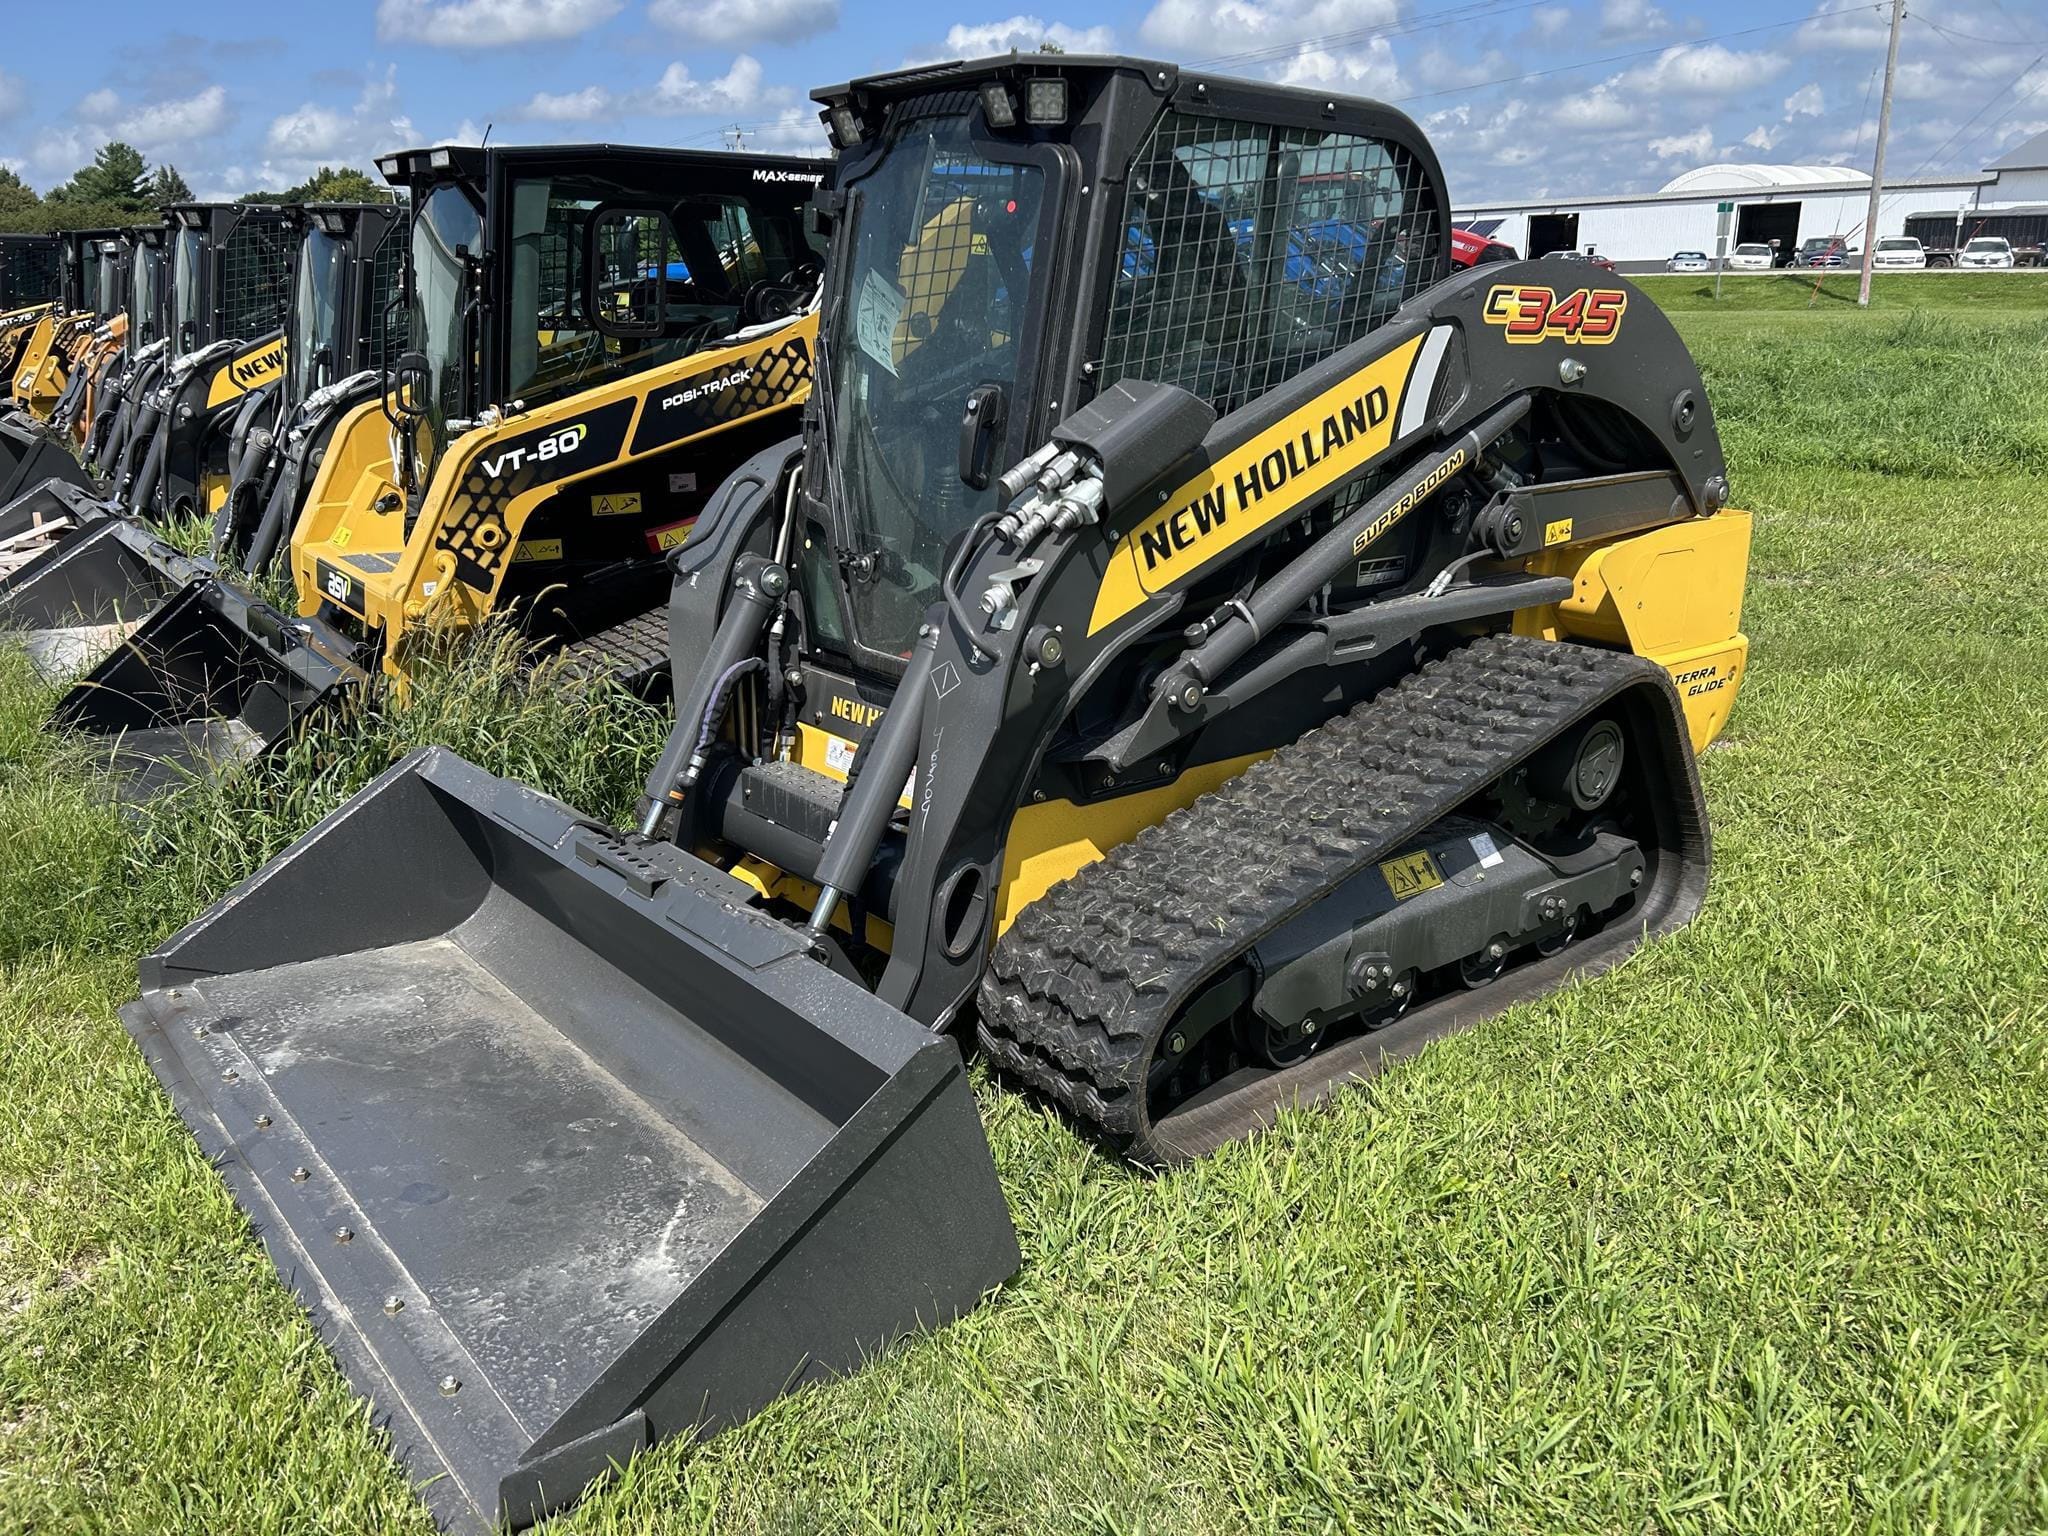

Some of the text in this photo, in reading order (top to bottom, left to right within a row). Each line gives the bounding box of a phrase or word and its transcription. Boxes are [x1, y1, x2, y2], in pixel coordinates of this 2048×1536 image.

[1483, 285, 1627, 342] C345
[236, 349, 282, 381] NEW
[481, 430, 579, 478] VT-80
[1139, 385, 1389, 571] NEW HOLLAND
[1354, 450, 1463, 555] SUPER BOOM
[1674, 666, 1716, 685] TERRA
[1688, 678, 1726, 696] GLIDE
[831, 695, 865, 725] NEW
